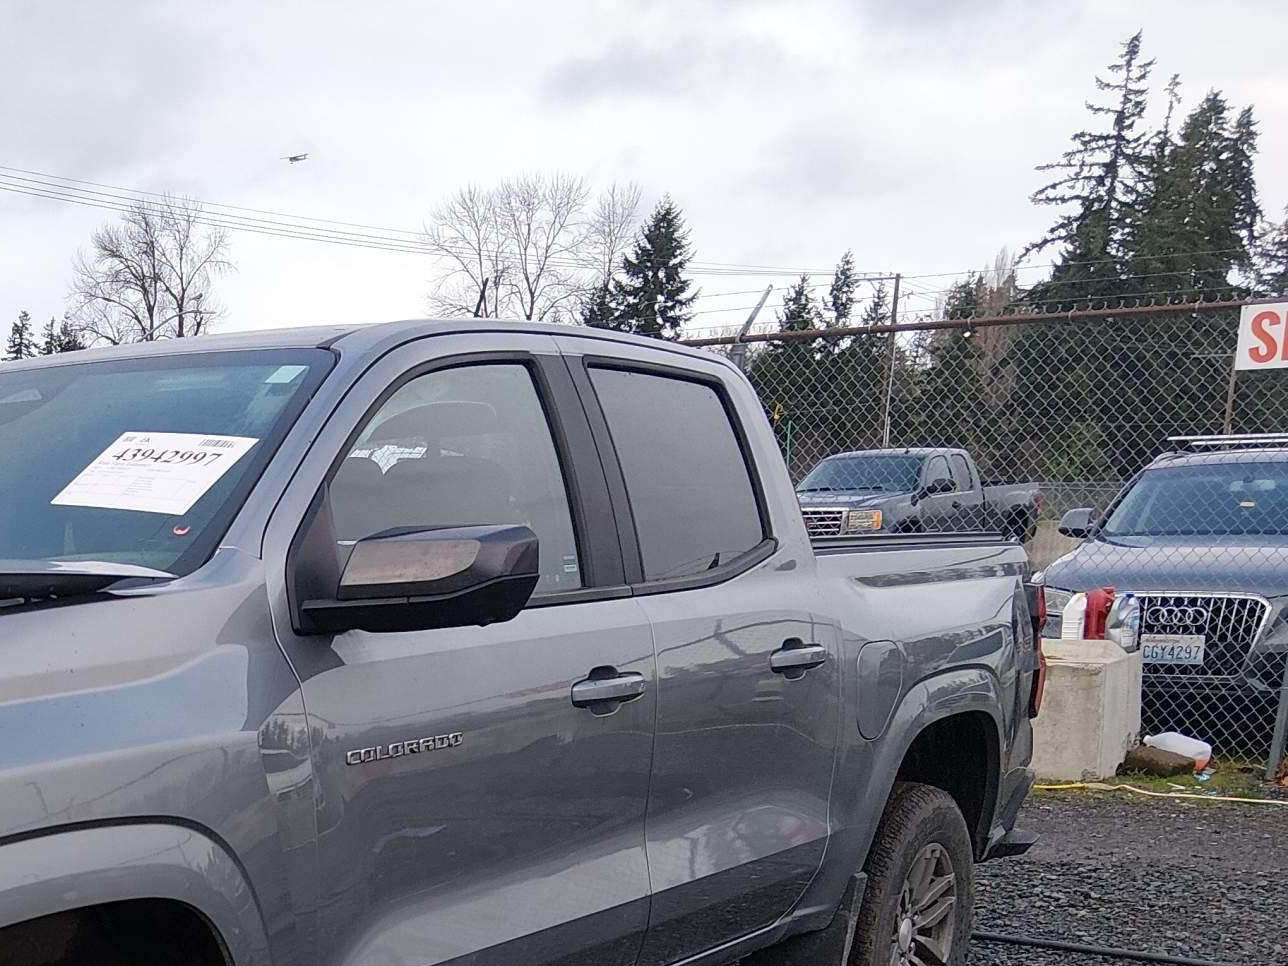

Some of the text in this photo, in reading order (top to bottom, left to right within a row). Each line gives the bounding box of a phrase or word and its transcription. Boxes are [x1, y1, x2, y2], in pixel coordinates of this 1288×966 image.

[112, 448, 224, 466] 43942997
[1143, 645, 1201, 660] CGY4297
[346, 732, 464, 765] COLORADO
